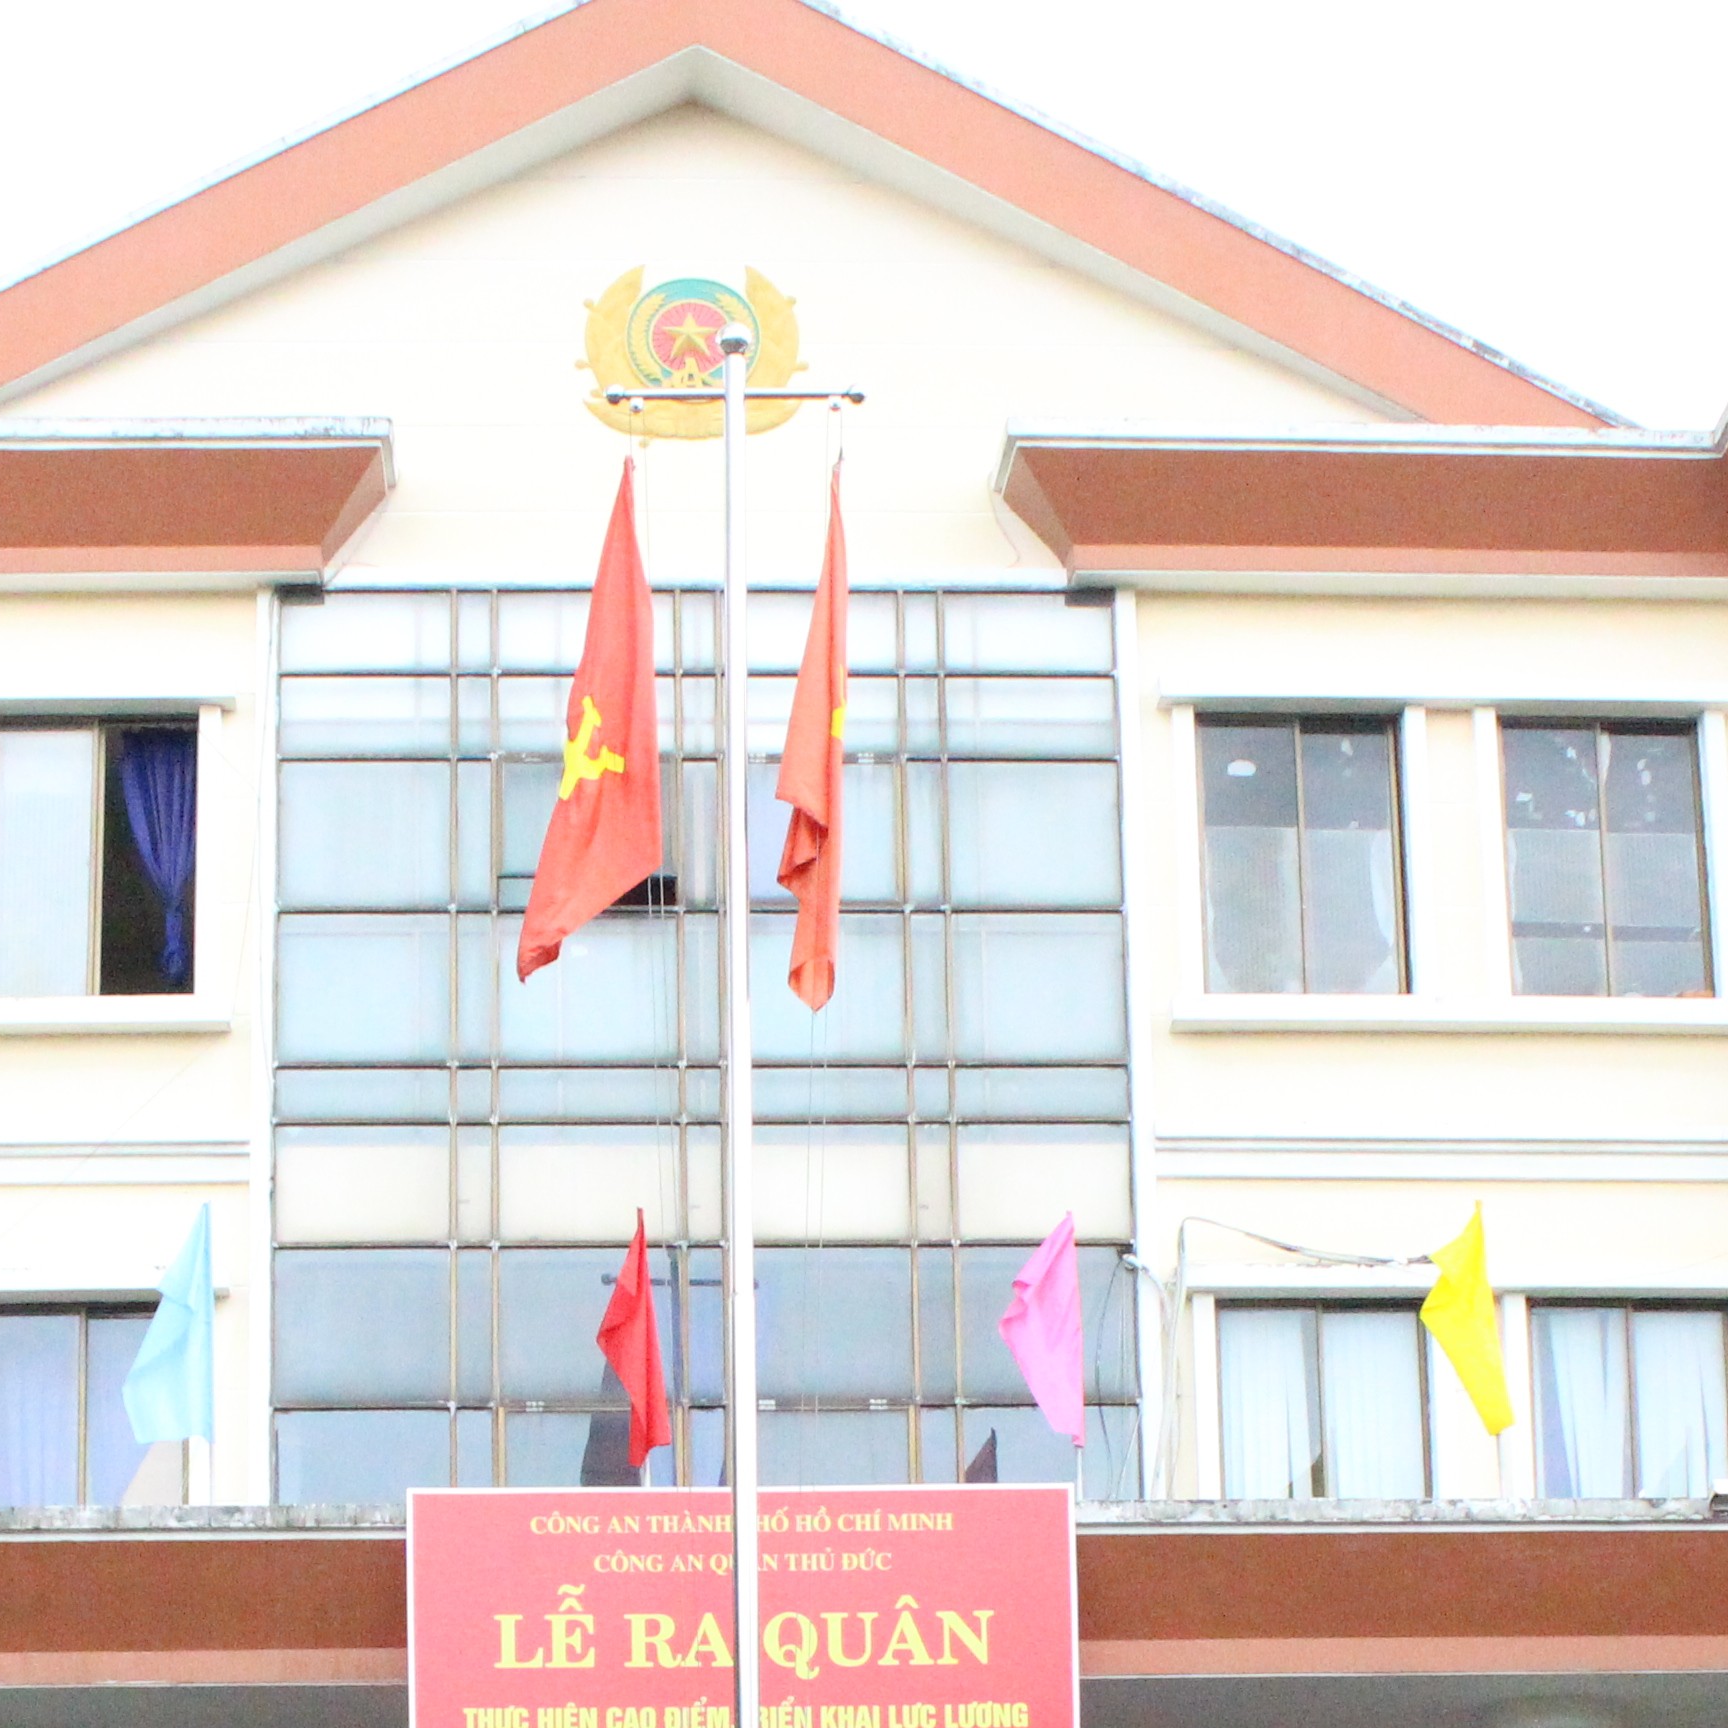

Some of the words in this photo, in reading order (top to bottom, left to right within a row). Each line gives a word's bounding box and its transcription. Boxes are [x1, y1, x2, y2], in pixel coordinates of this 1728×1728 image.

[530, 1511, 600, 1535] CÔNG
[608, 1515, 640, 1534] AN
[646, 1510, 733, 1534] THÀNH
[757, 1506, 789, 1532] HỐ
[795, 1505, 831, 1532] HỒ
[837, 1508, 882, 1532] CHÍ
[887, 1512, 953, 1531] MINH
[594, 1549, 663, 1573] CÔNG
[671, 1554, 703, 1573] AN
[785, 1547, 835, 1571] THỦ
[842, 1547, 892, 1571] ĐỨC
[494, 1584, 595, 1669] LỄ
[624, 1611, 734, 1669] RA
[762, 1593, 995, 1681] QUÂN
